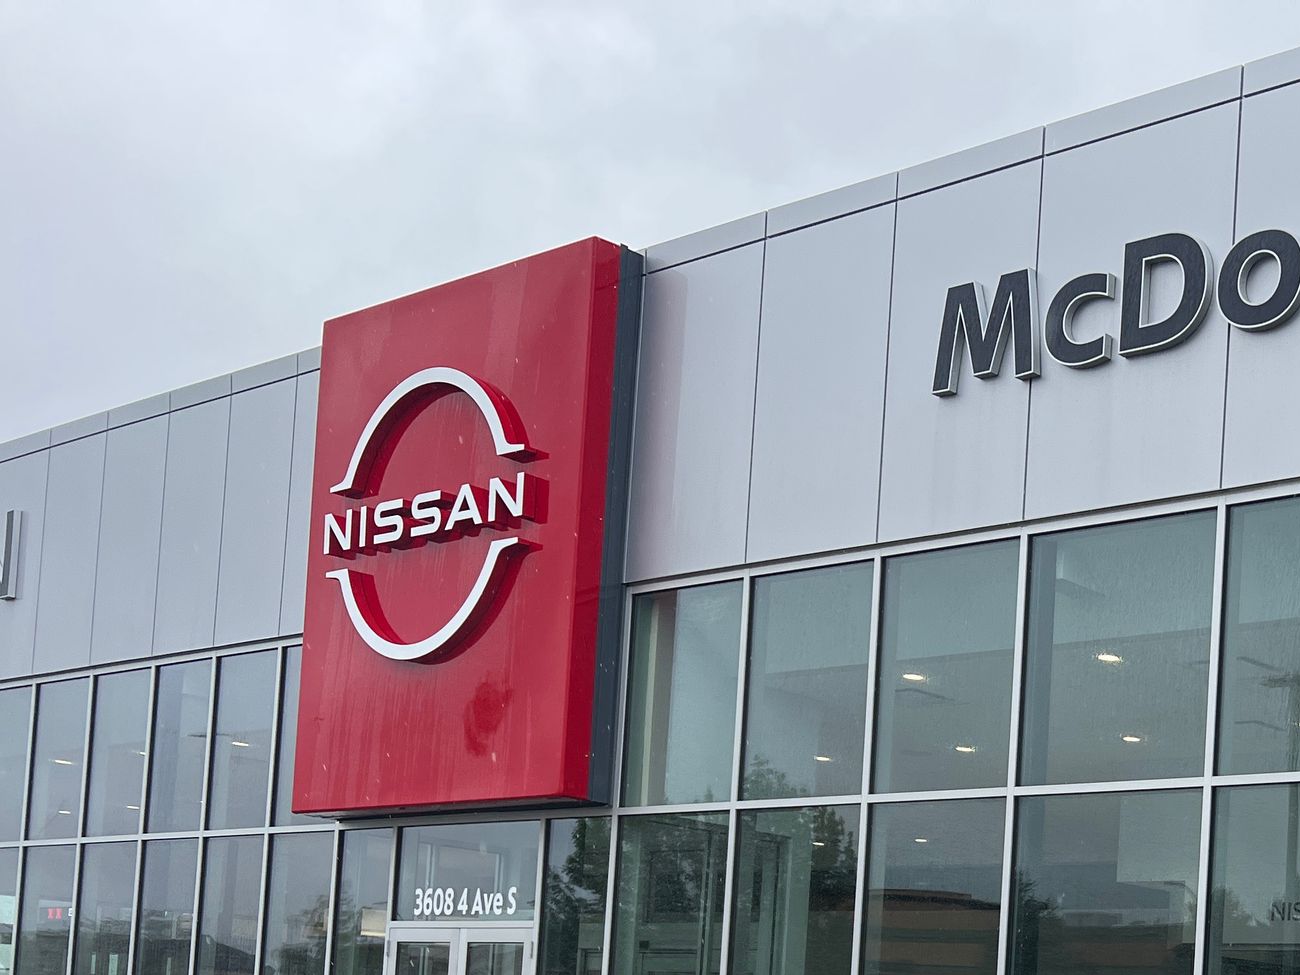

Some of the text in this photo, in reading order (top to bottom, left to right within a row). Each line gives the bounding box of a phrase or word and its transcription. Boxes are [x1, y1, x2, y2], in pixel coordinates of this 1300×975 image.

[323, 471, 525, 555] NISSAN
[413, 886, 517, 915] 3608 4 Ave S
